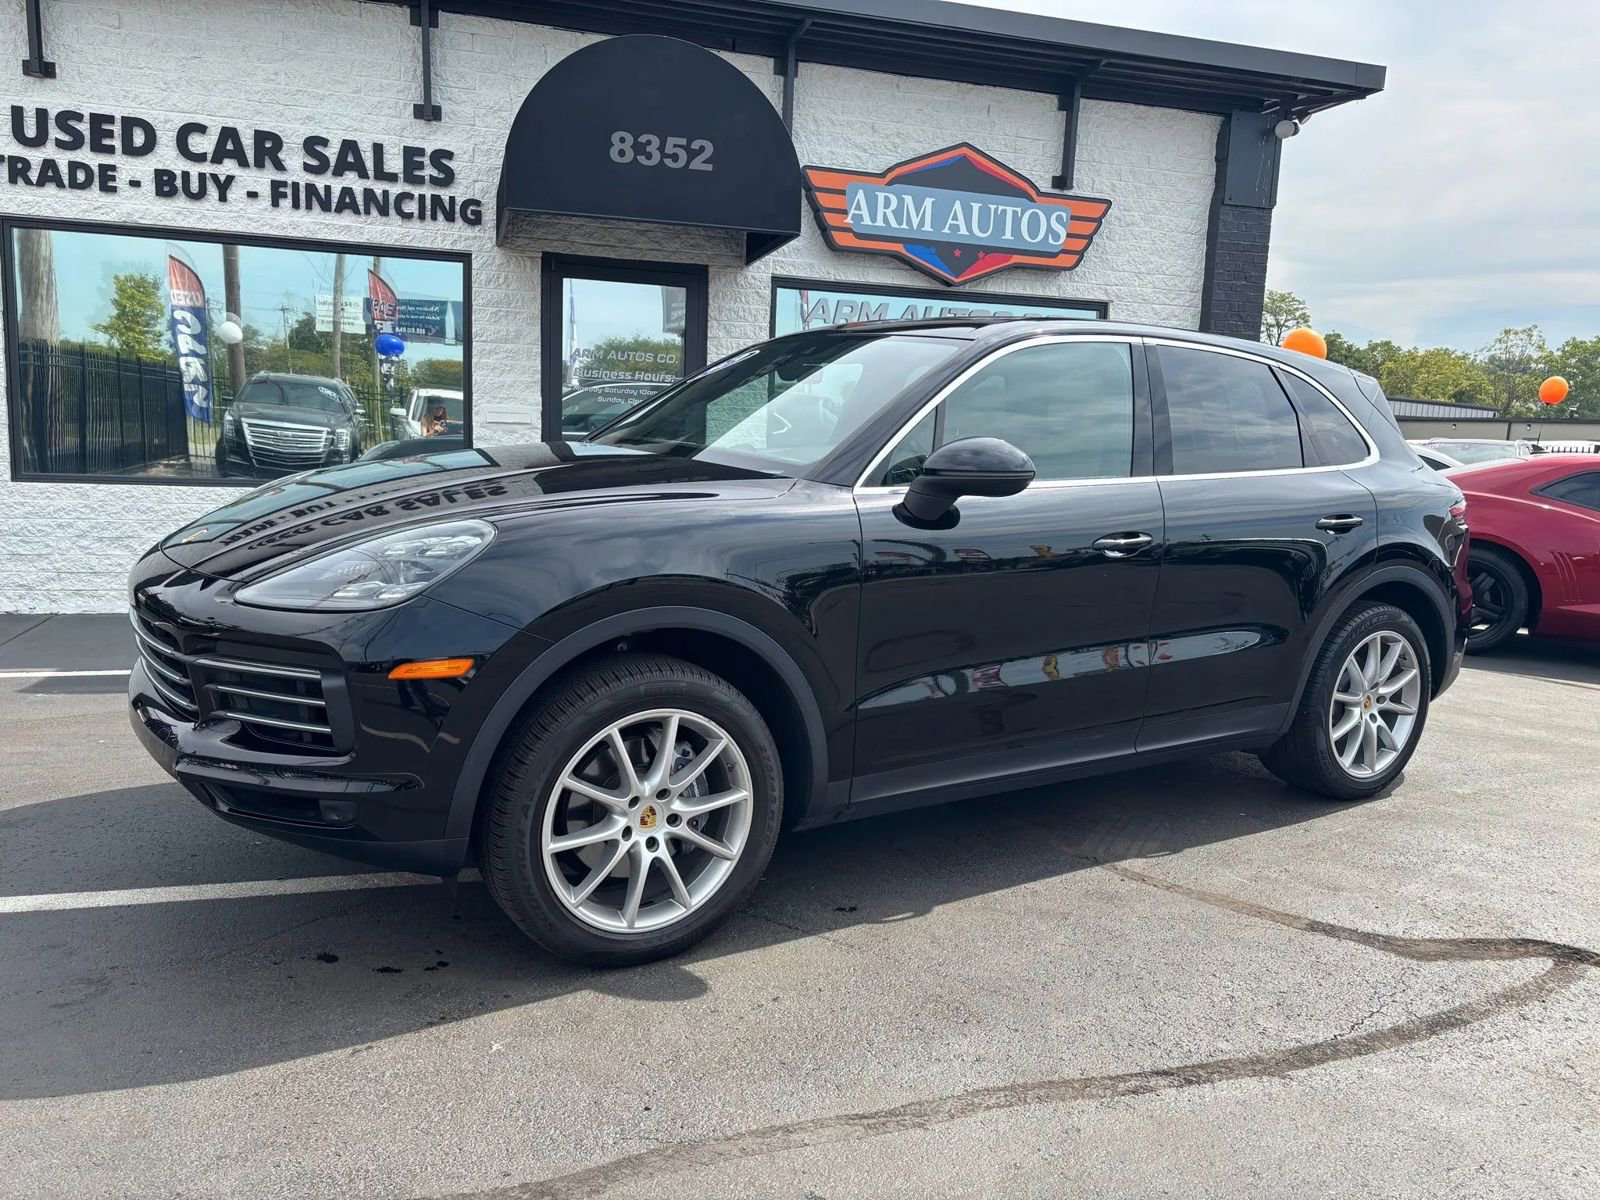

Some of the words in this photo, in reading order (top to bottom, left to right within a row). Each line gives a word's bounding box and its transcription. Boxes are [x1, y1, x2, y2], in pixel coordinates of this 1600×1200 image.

[11, 105, 157, 156] USED
[176, 122, 287, 171] CAR
[303, 135, 455, 187] SALES
[609, 130, 714, 172] 8352
[154, 168, 236, 202] BUY
[271, 179, 482, 226] FINANCING
[844, 188, 936, 232] ARM
[941, 199, 1067, 246] AUTOS
[805, 297, 889, 324] ARM
[573, 347, 603, 360] ARM
[607, 350, 654, 362] AUTOS
[656, 354, 679, 364] CO.
[573, 366, 632, 381] Business
[634, 370, 675, 383] Hours:
